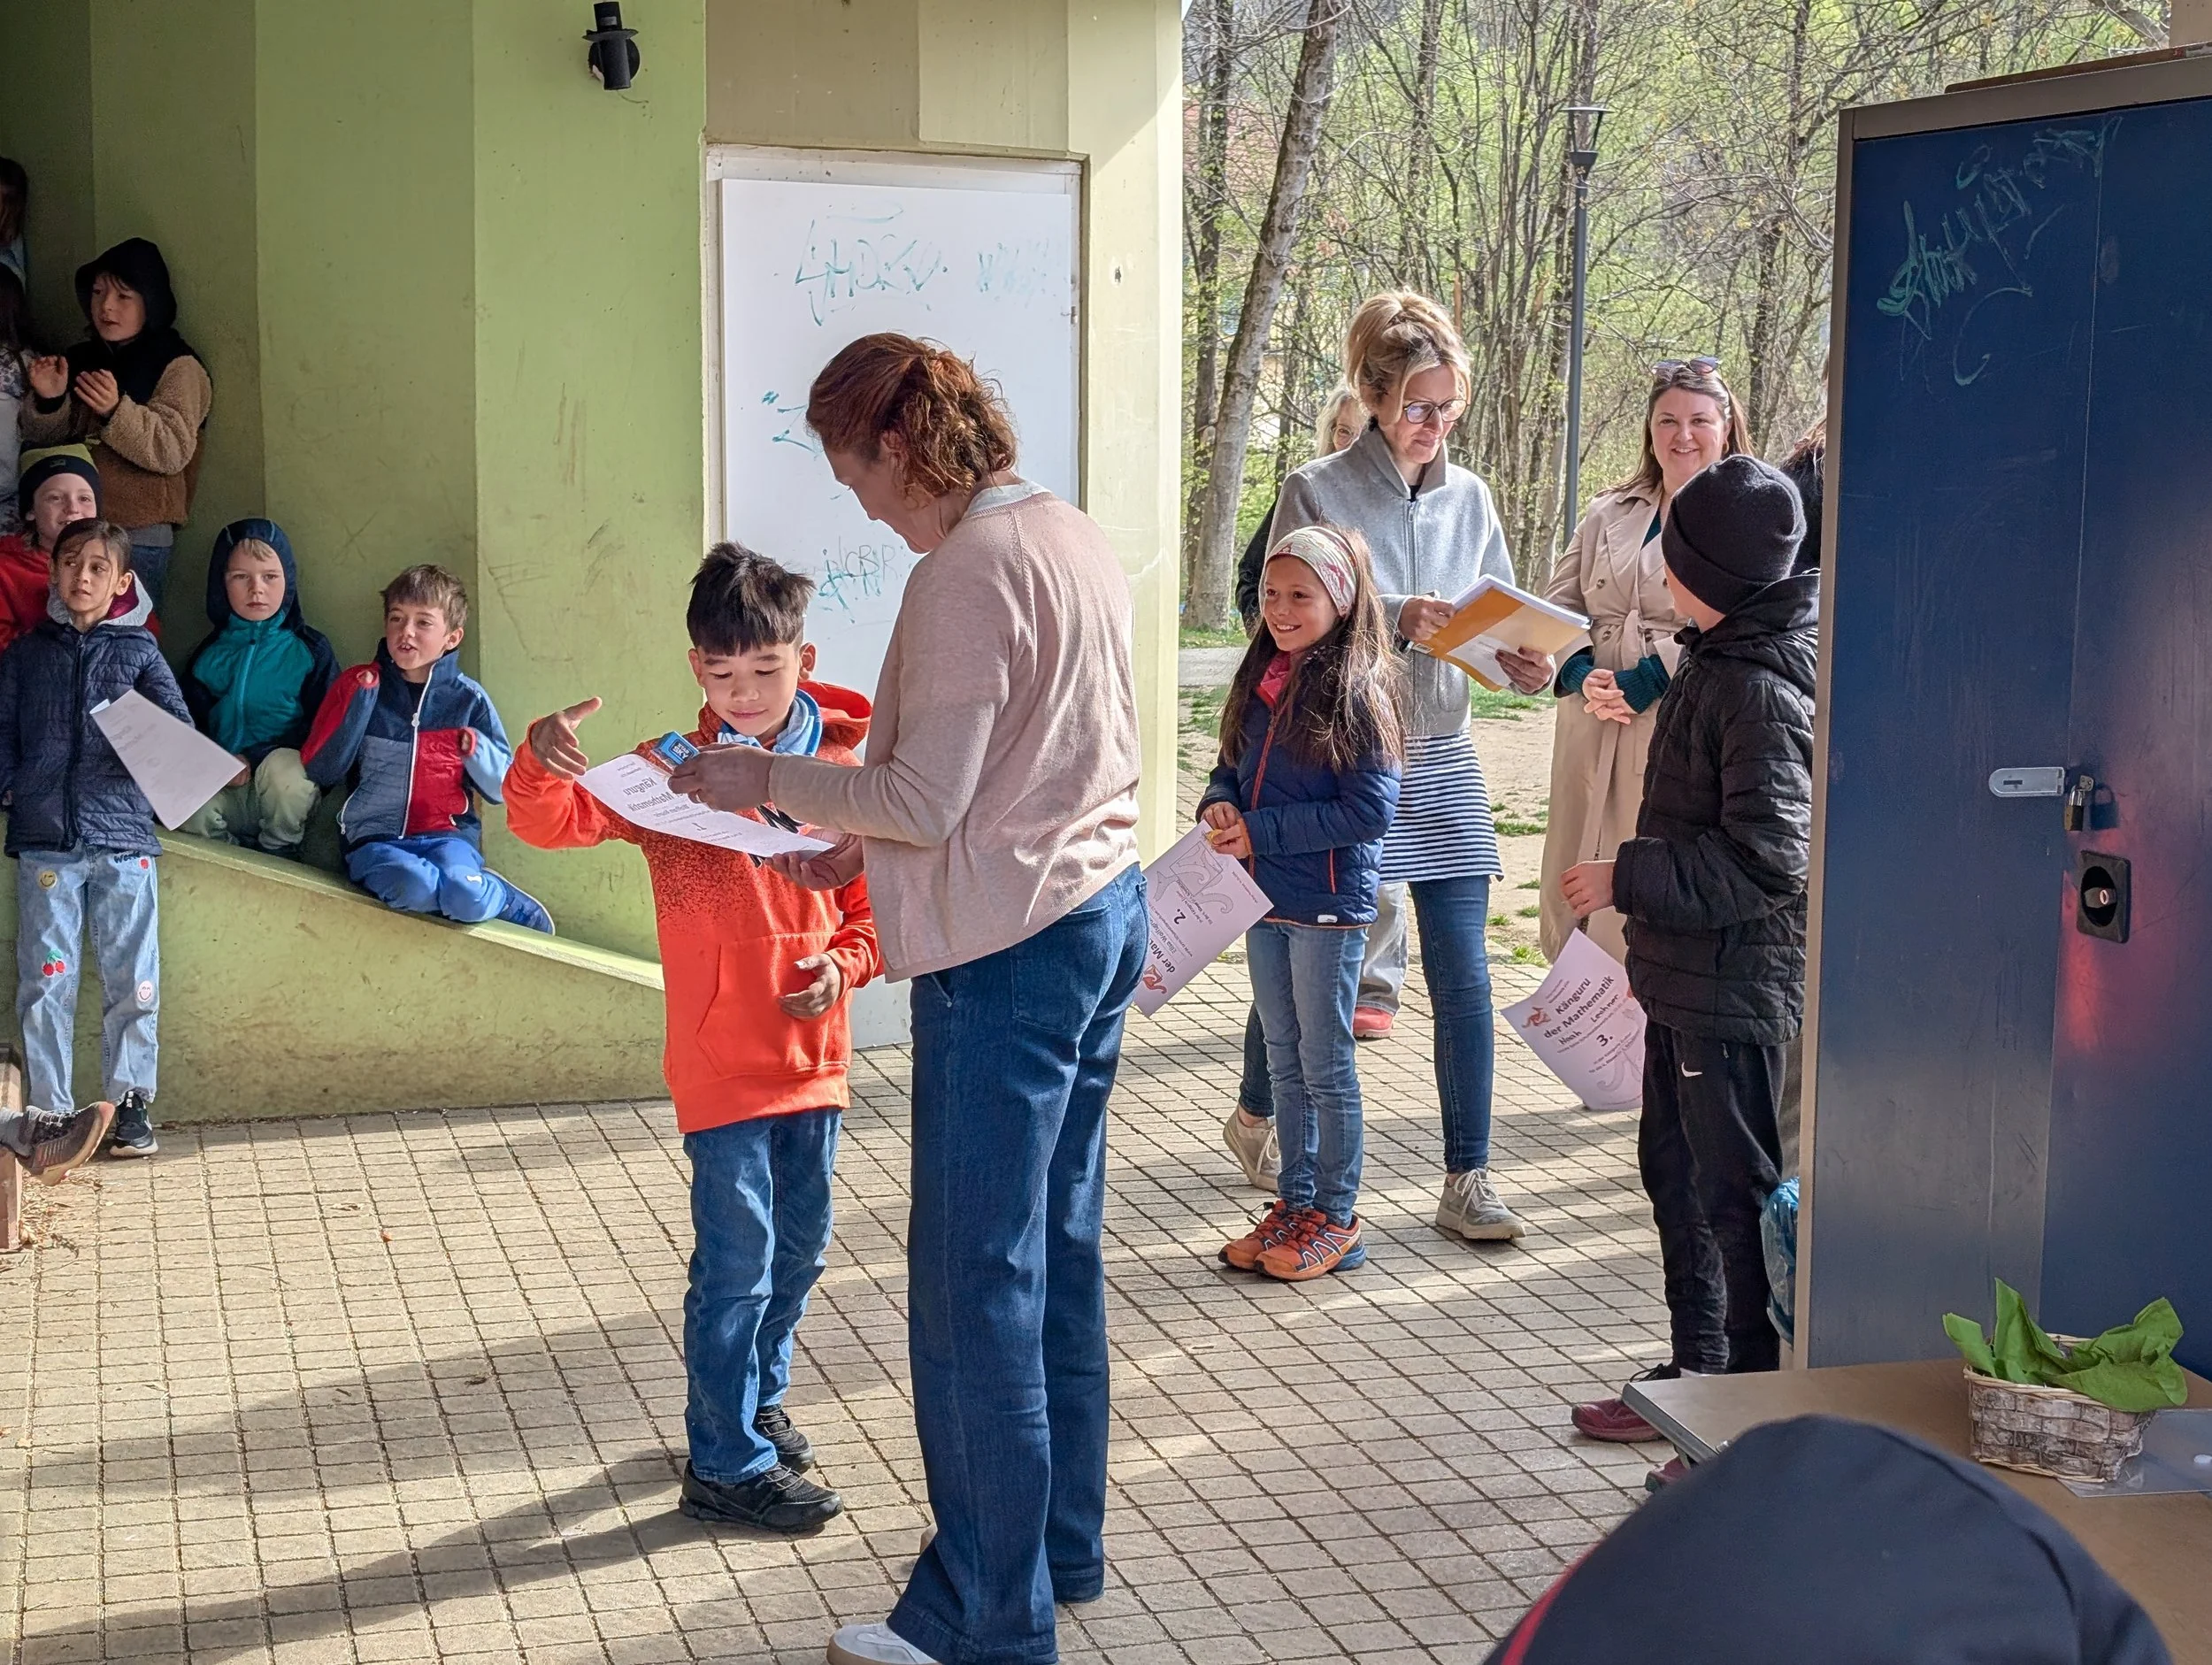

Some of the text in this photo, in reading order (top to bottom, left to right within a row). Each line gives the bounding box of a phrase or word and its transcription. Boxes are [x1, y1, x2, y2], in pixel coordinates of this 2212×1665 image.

[672, 746, 688, 759] SKY
[1173, 908, 1187, 925] 2.
[1161, 957, 1176, 973] der
[1555, 978, 1592, 1015] Känguru
[1543, 1025, 1563, 1039] der
[1563, 975, 1615, 1029] Mathematik
[1596, 1033, 1614, 1047] 3.
